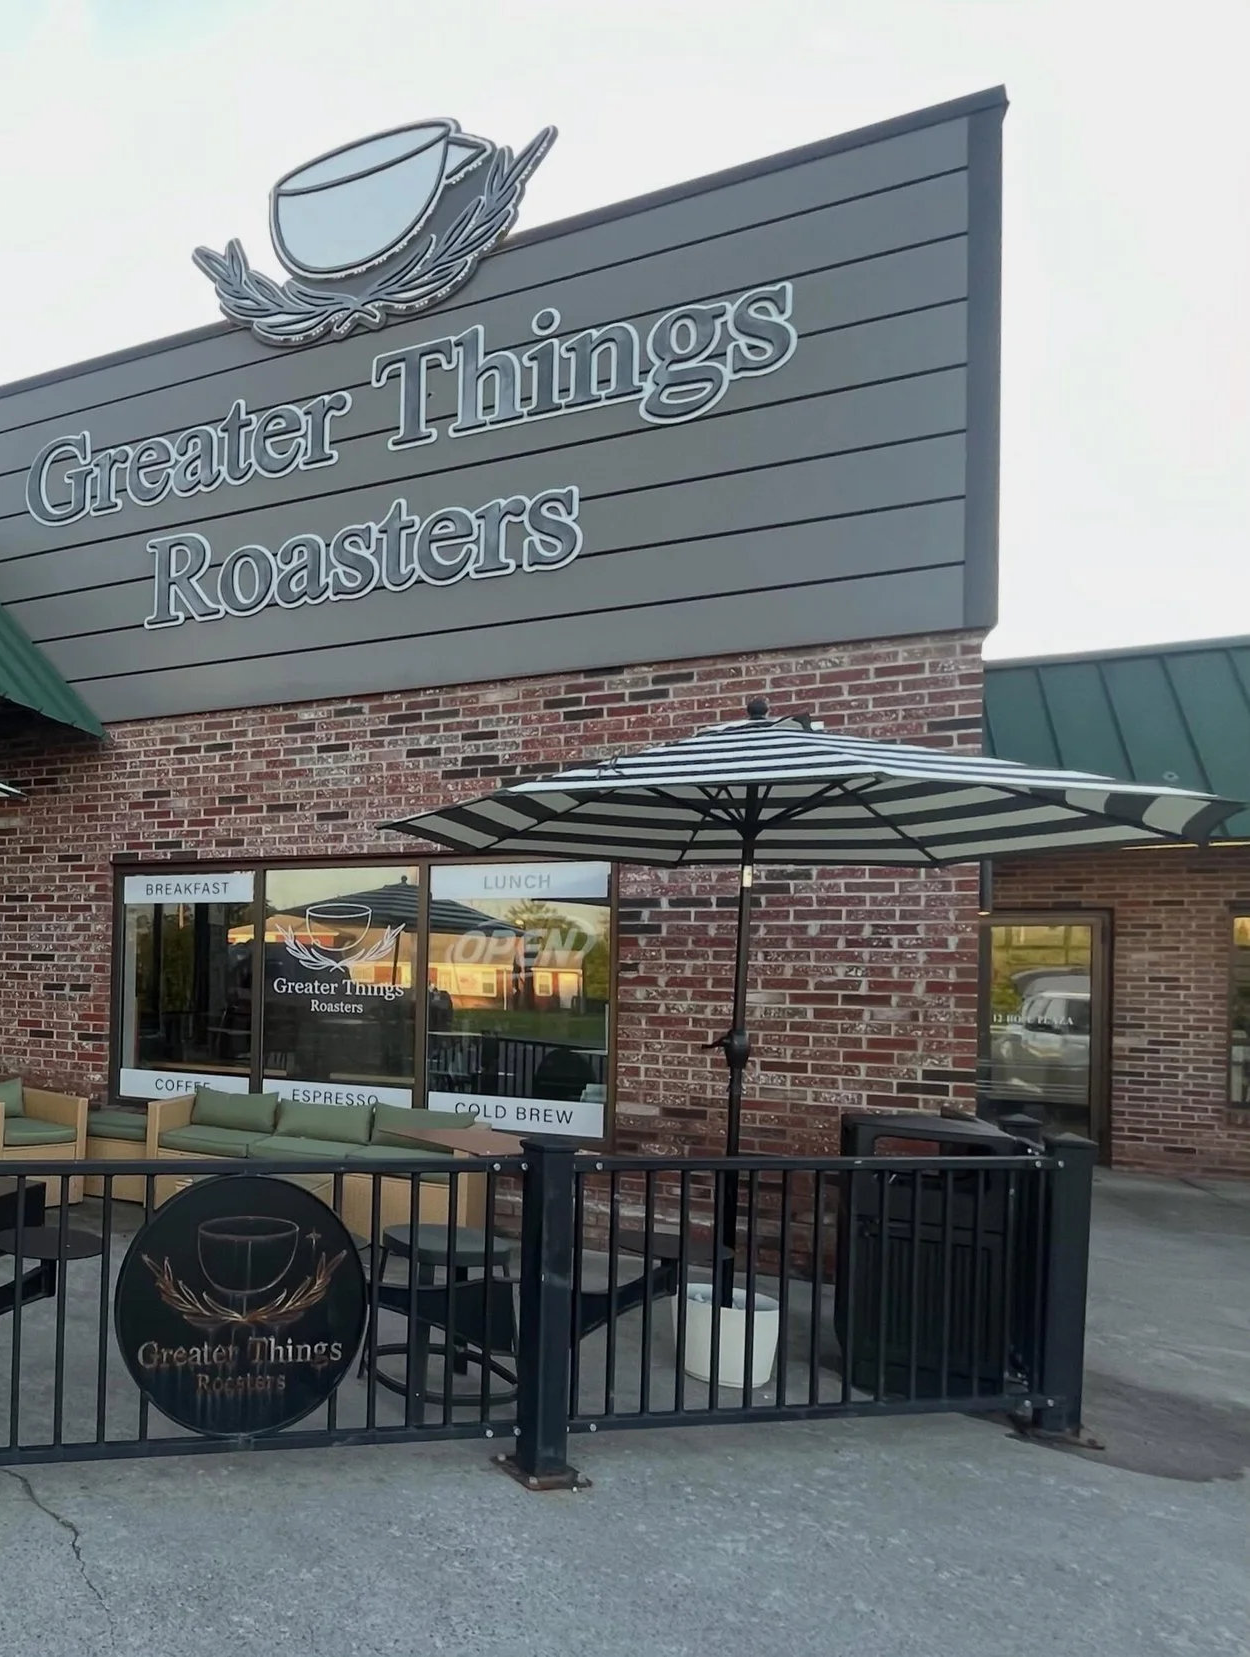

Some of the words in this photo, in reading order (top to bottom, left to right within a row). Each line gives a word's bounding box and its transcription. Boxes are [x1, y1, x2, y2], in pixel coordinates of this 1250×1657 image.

[26, 389, 352, 528] Greater
[371, 281, 797, 450] Things
[144, 484, 583, 630] Roasters
[145, 881, 230, 896] BREAKFAST
[483, 873, 551, 890] LUNCH
[453, 928, 579, 967] OPEN
[273, 977, 339, 995] Greater
[342, 979, 405, 1001] Things
[310, 999, 364, 1014] Roasters
[292, 1087, 379, 1107] ESPRESSO
[454, 1102, 507, 1119] COLD
[516, 1106, 574, 1124] BREW
[137, 1340, 238, 1369] Greater
[249, 1336, 343, 1368] Things
[197, 1373, 287, 1393] Roasters
